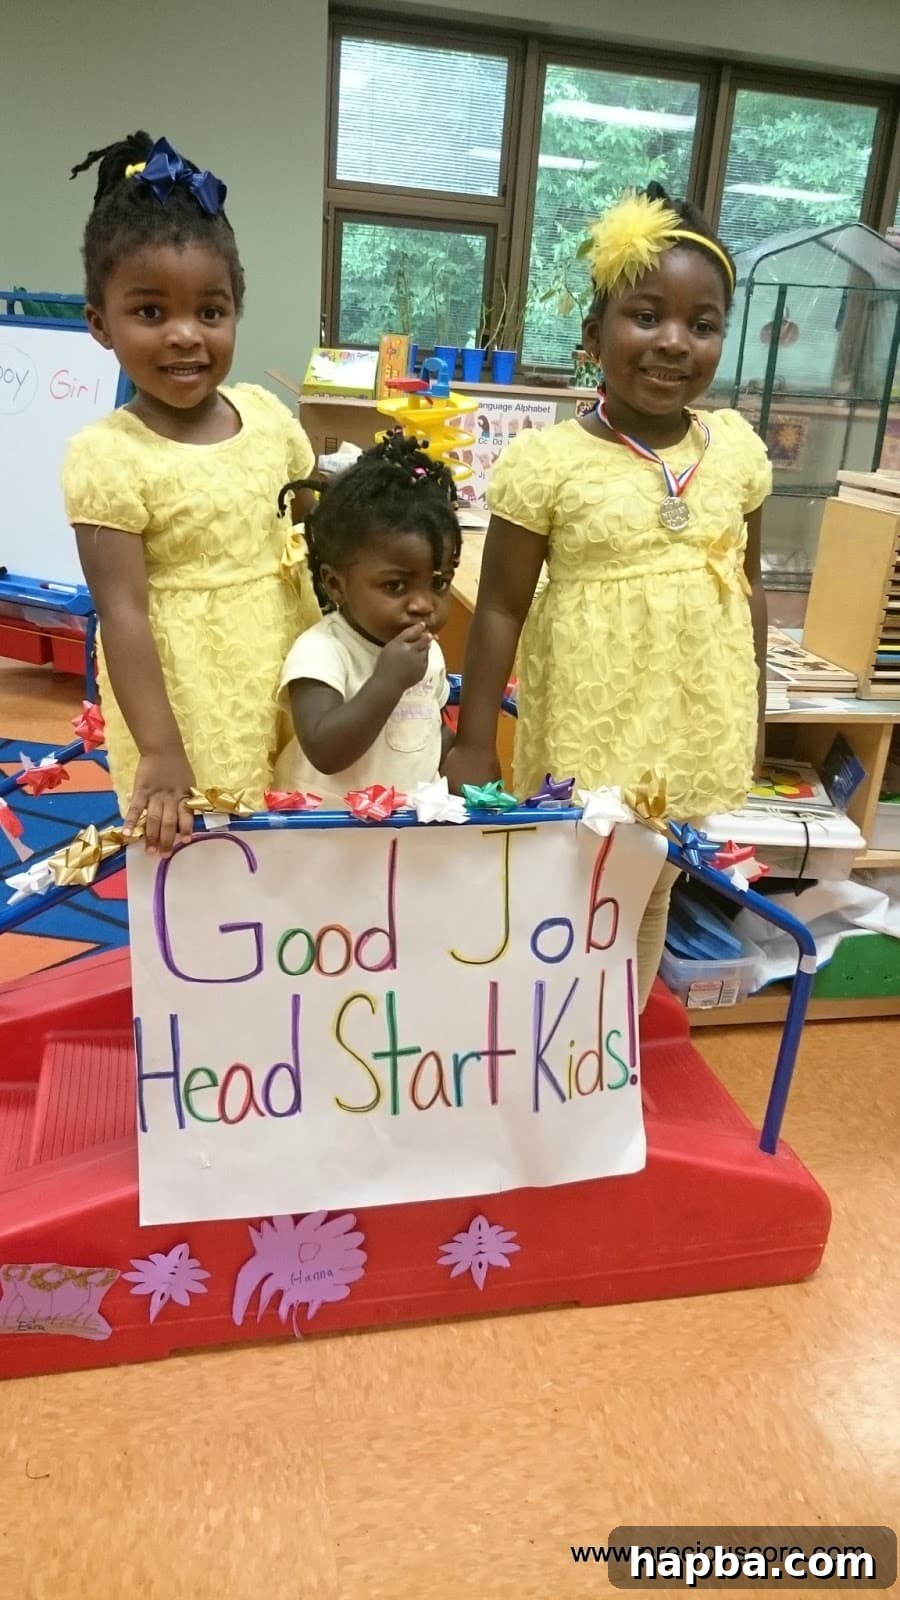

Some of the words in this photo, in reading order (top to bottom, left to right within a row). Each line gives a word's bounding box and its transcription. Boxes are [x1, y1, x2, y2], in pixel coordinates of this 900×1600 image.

[49, 369, 100, 404] Girl
[479, 402, 513, 412] anguage
[515, 403, 551, 414] Alphabet
[153, 831, 398, 984] Good
[449, 827, 620, 967] Job
[134, 994, 301, 1133] Head
[331, 980, 516, 1115] Start
[532, 958, 639, 1113] Kids!
[290, 1269, 335, 1286] Hanna
